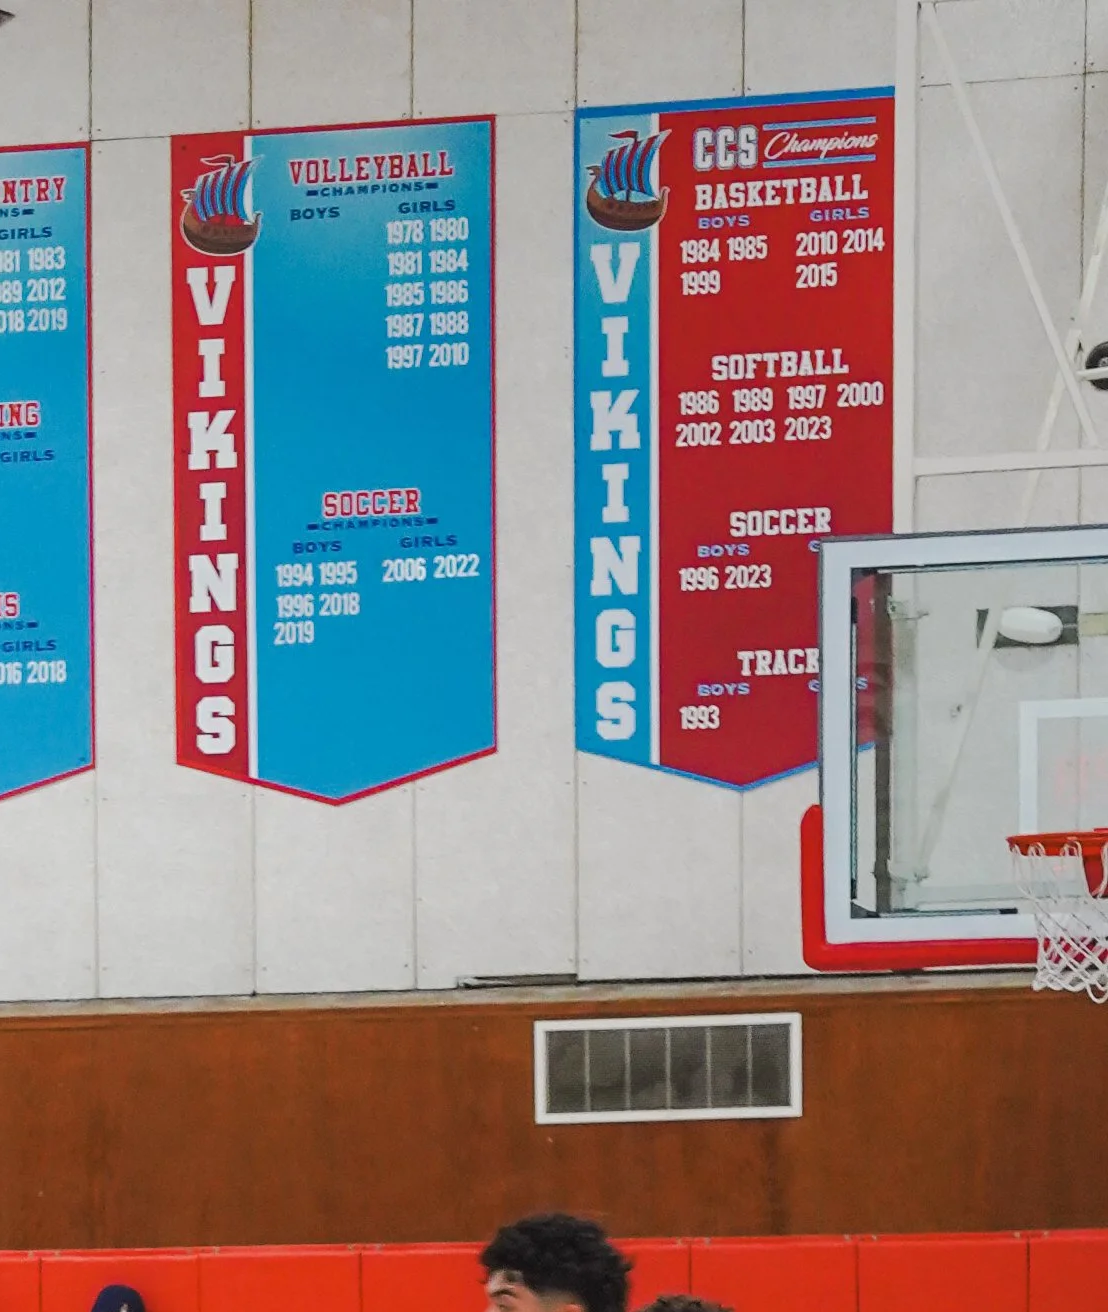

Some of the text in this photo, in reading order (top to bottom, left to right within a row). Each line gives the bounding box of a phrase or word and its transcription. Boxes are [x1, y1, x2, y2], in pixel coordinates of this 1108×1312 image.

[692, 125, 758, 171] CCS
[765, 131, 879, 160] Champions
[288, 151, 454, 185] VOLLEYBALL
[321, 183, 425, 197] CHAMPIONS
[695, 174, 868, 210] BASKETBALL
[291, 207, 340, 220] BOYS
[398, 200, 455, 214] GIRLS
[810, 207, 870, 221] GIRLS
[386, 217, 468, 244] 1978 1980
[698, 215, 750, 229] BOYS
[680, 235, 768, 264] 1984 1985
[796, 228, 885, 256] 2010 2014
[28, 247, 65, 270] 1983
[387, 249, 468, 276] 1981 1984
[681, 270, 721, 295] 1999
[796, 263, 838, 288] 2015
[26, 278, 66, 301] 2012
[385, 280, 468, 306] 1985 1986
[27, 308, 67, 331] 2019
[386, 311, 468, 338] 1987 1988
[385, 342, 469, 369] 1997 2010
[711, 348, 849, 381] SOFTBALL
[678, 381, 884, 416] 1986 1989 1997 2000
[676, 416, 832, 447] 2002 2003 2023
[0, 450, 55, 463] GIRLS
[323, 488, 421, 518] SOCCER
[590, 242, 641, 741] VIKINGS
[187, 266, 238, 754] VIKINGS
[729, 507, 832, 537] SOCCER
[293, 541, 342, 554] BOYS
[400, 535, 458, 549] GIRLS
[698, 544, 750, 557] BOYS
[276, 561, 358, 587] 1994 1995
[382, 555, 480, 582] 2006 2022
[679, 565, 772, 591] 1996 2023
[276, 593, 360, 618] 1996 2018
[1, 640, 57, 652] GIRLS
[274, 621, 314, 645] 2019
[27, 661, 66, 683] 2018
[698, 683, 750, 696] BOYS
[680, 705, 720, 730] 1993
